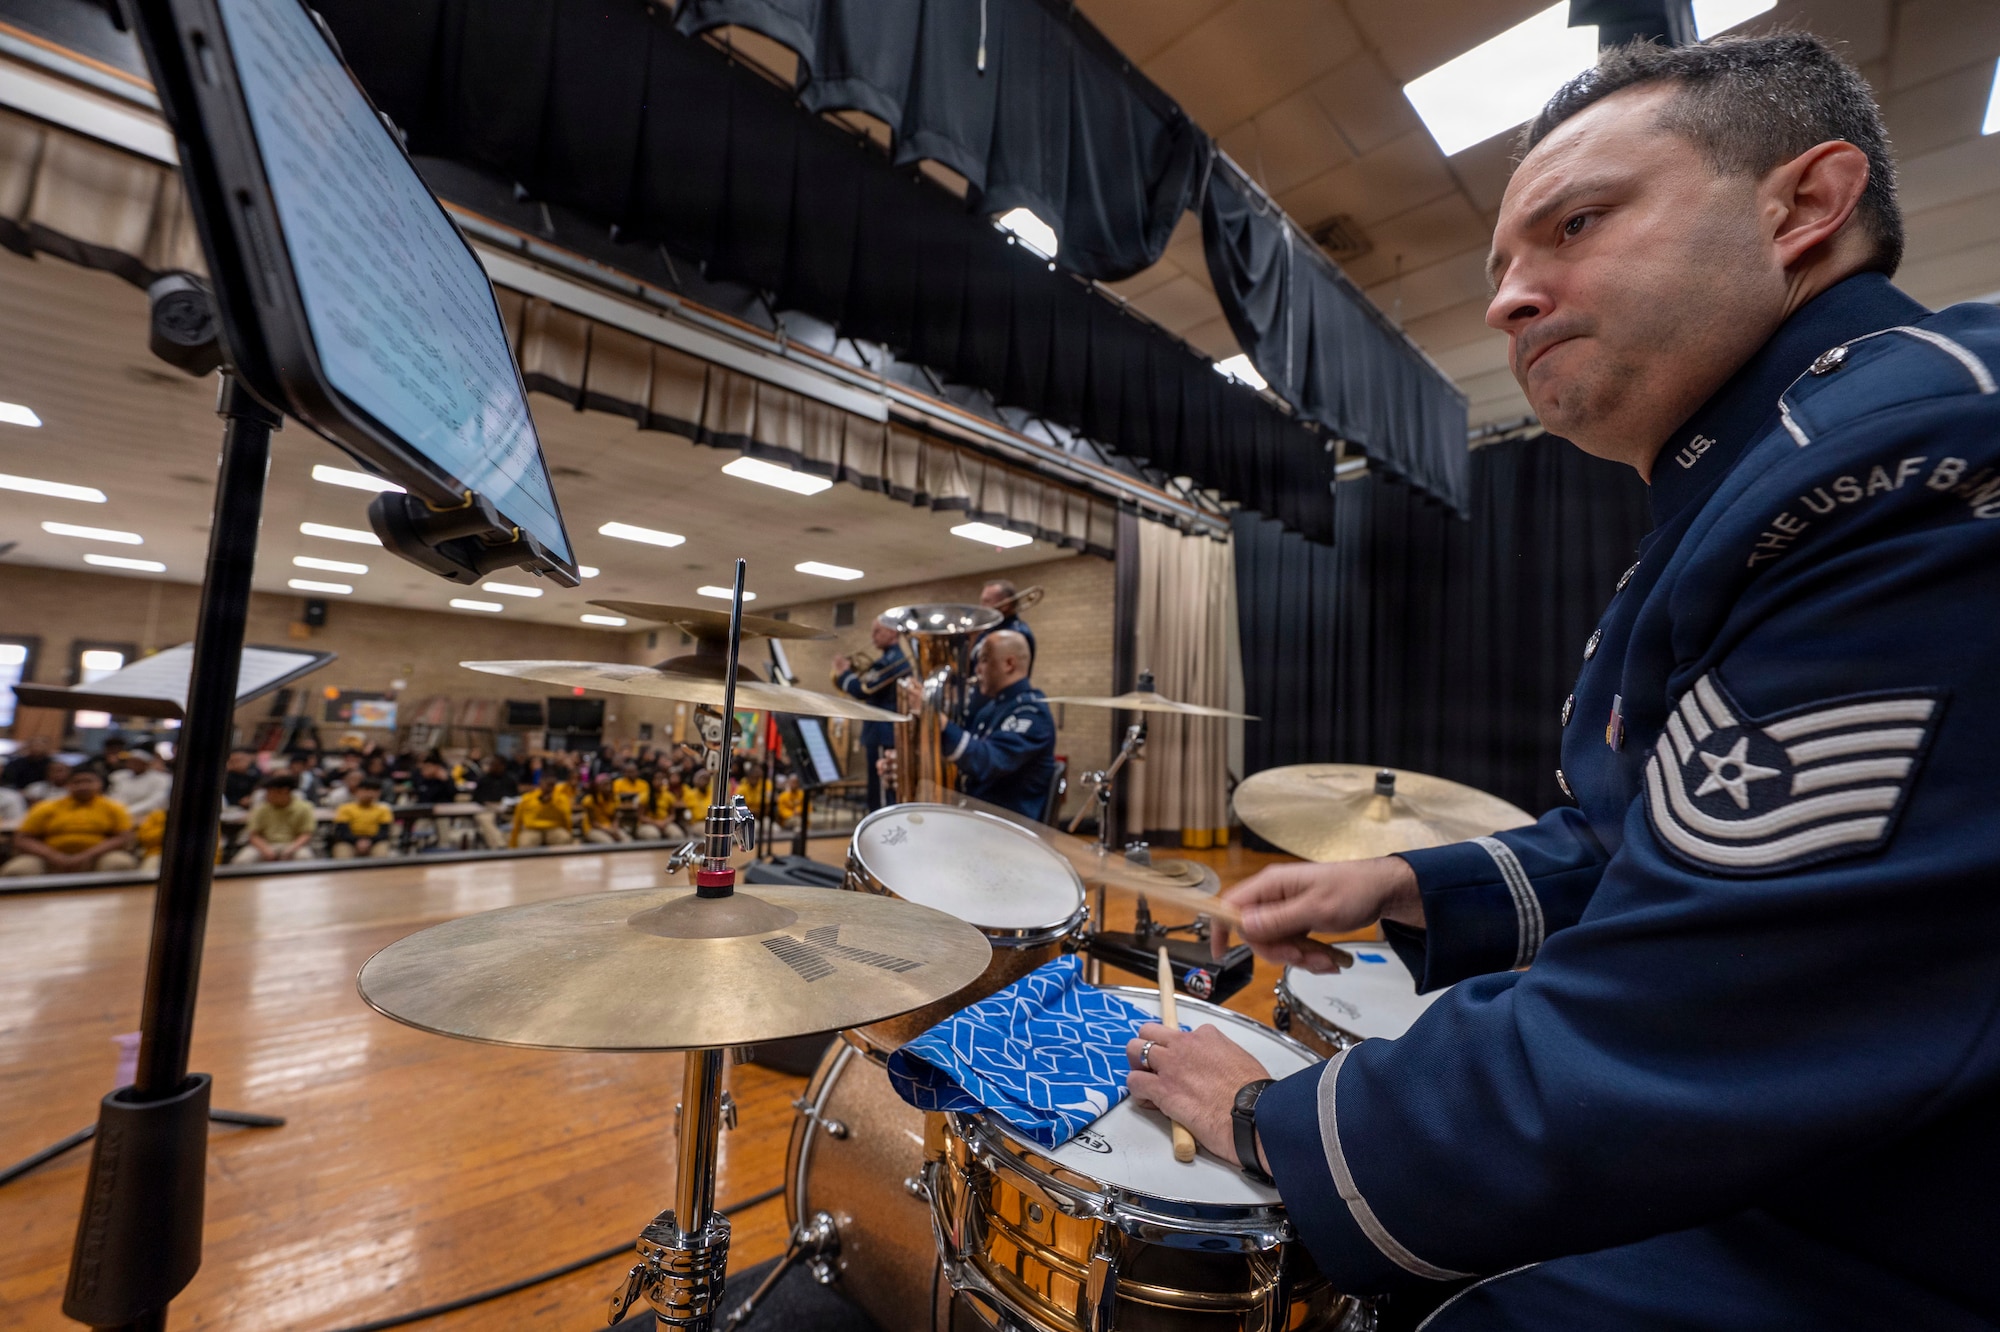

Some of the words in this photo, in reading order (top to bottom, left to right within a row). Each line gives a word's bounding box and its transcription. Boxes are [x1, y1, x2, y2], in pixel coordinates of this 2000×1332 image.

[1675, 434, 1717, 469] U.S.
[1747, 512, 1811, 568] THE
[1801, 455, 1928, 514] USAF
[760, 924, 926, 983] K
